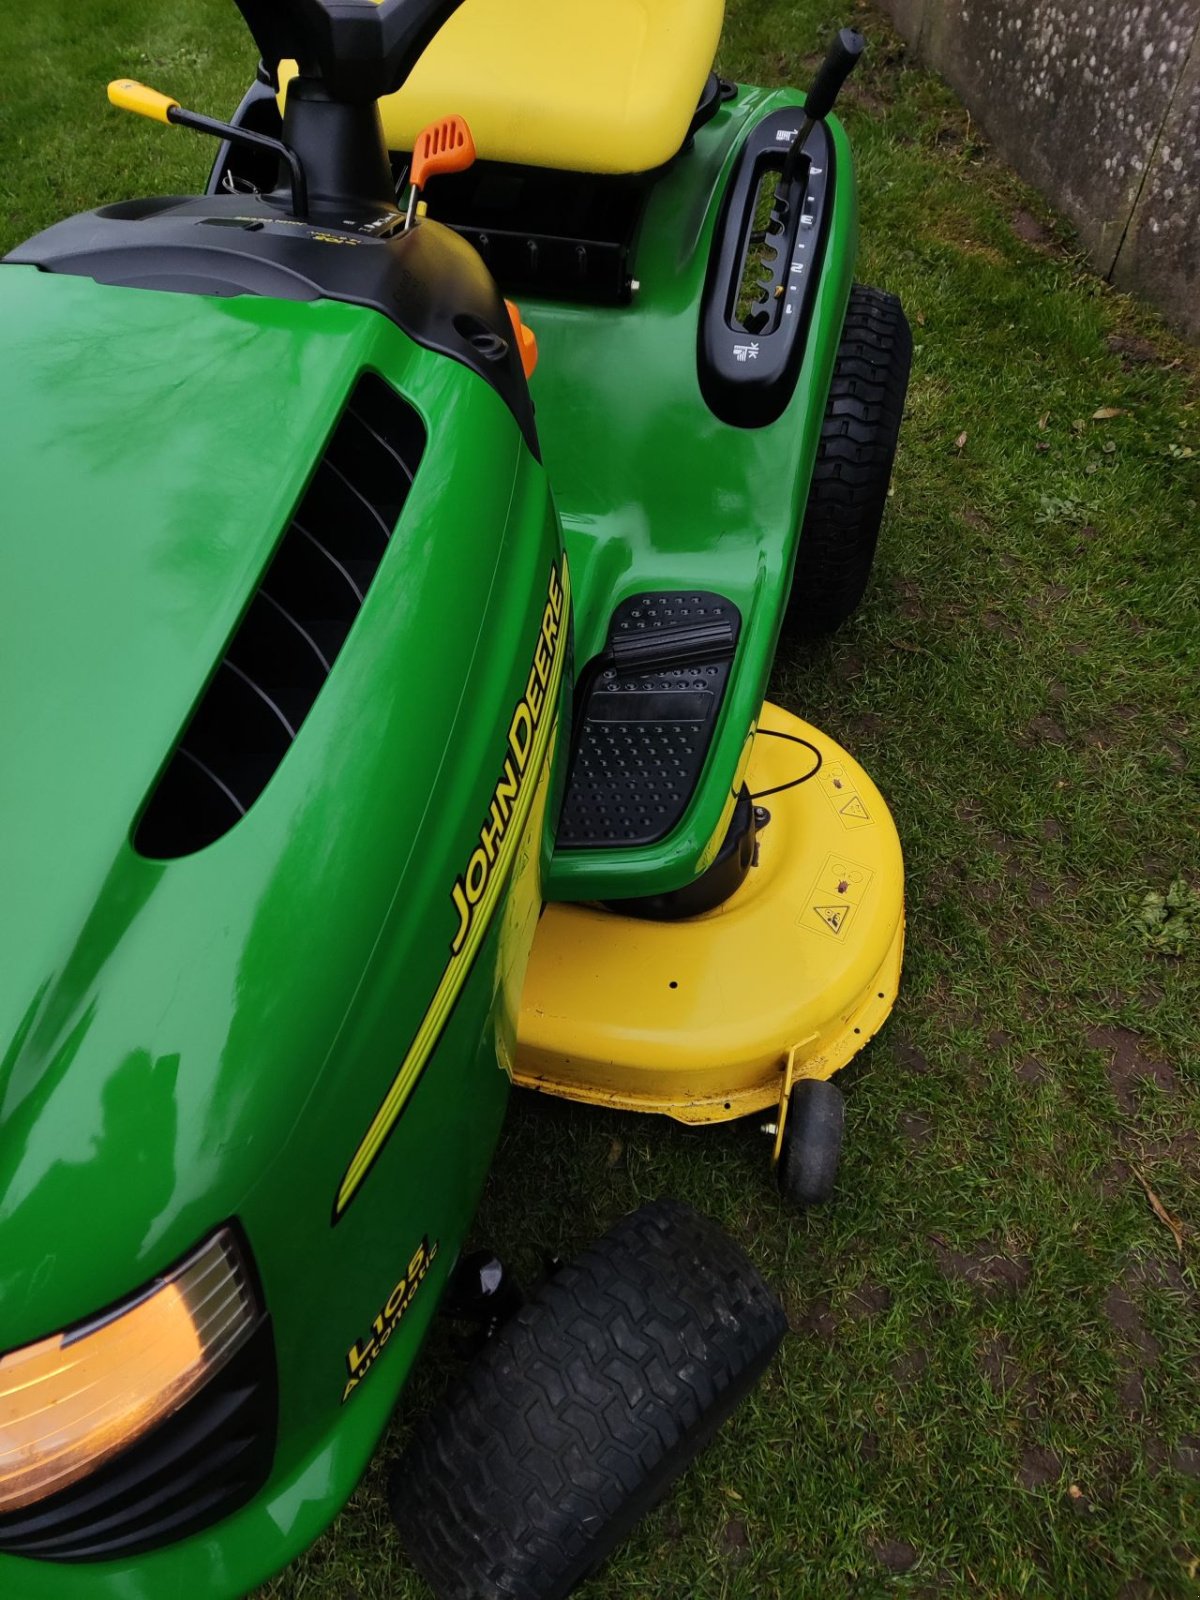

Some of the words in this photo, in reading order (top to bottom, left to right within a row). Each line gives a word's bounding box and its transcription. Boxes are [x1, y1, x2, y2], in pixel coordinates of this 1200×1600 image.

[451, 763, 522, 951] JOHN
[509, 566, 563, 773] DEERE
[347, 1241, 426, 1374] L105
